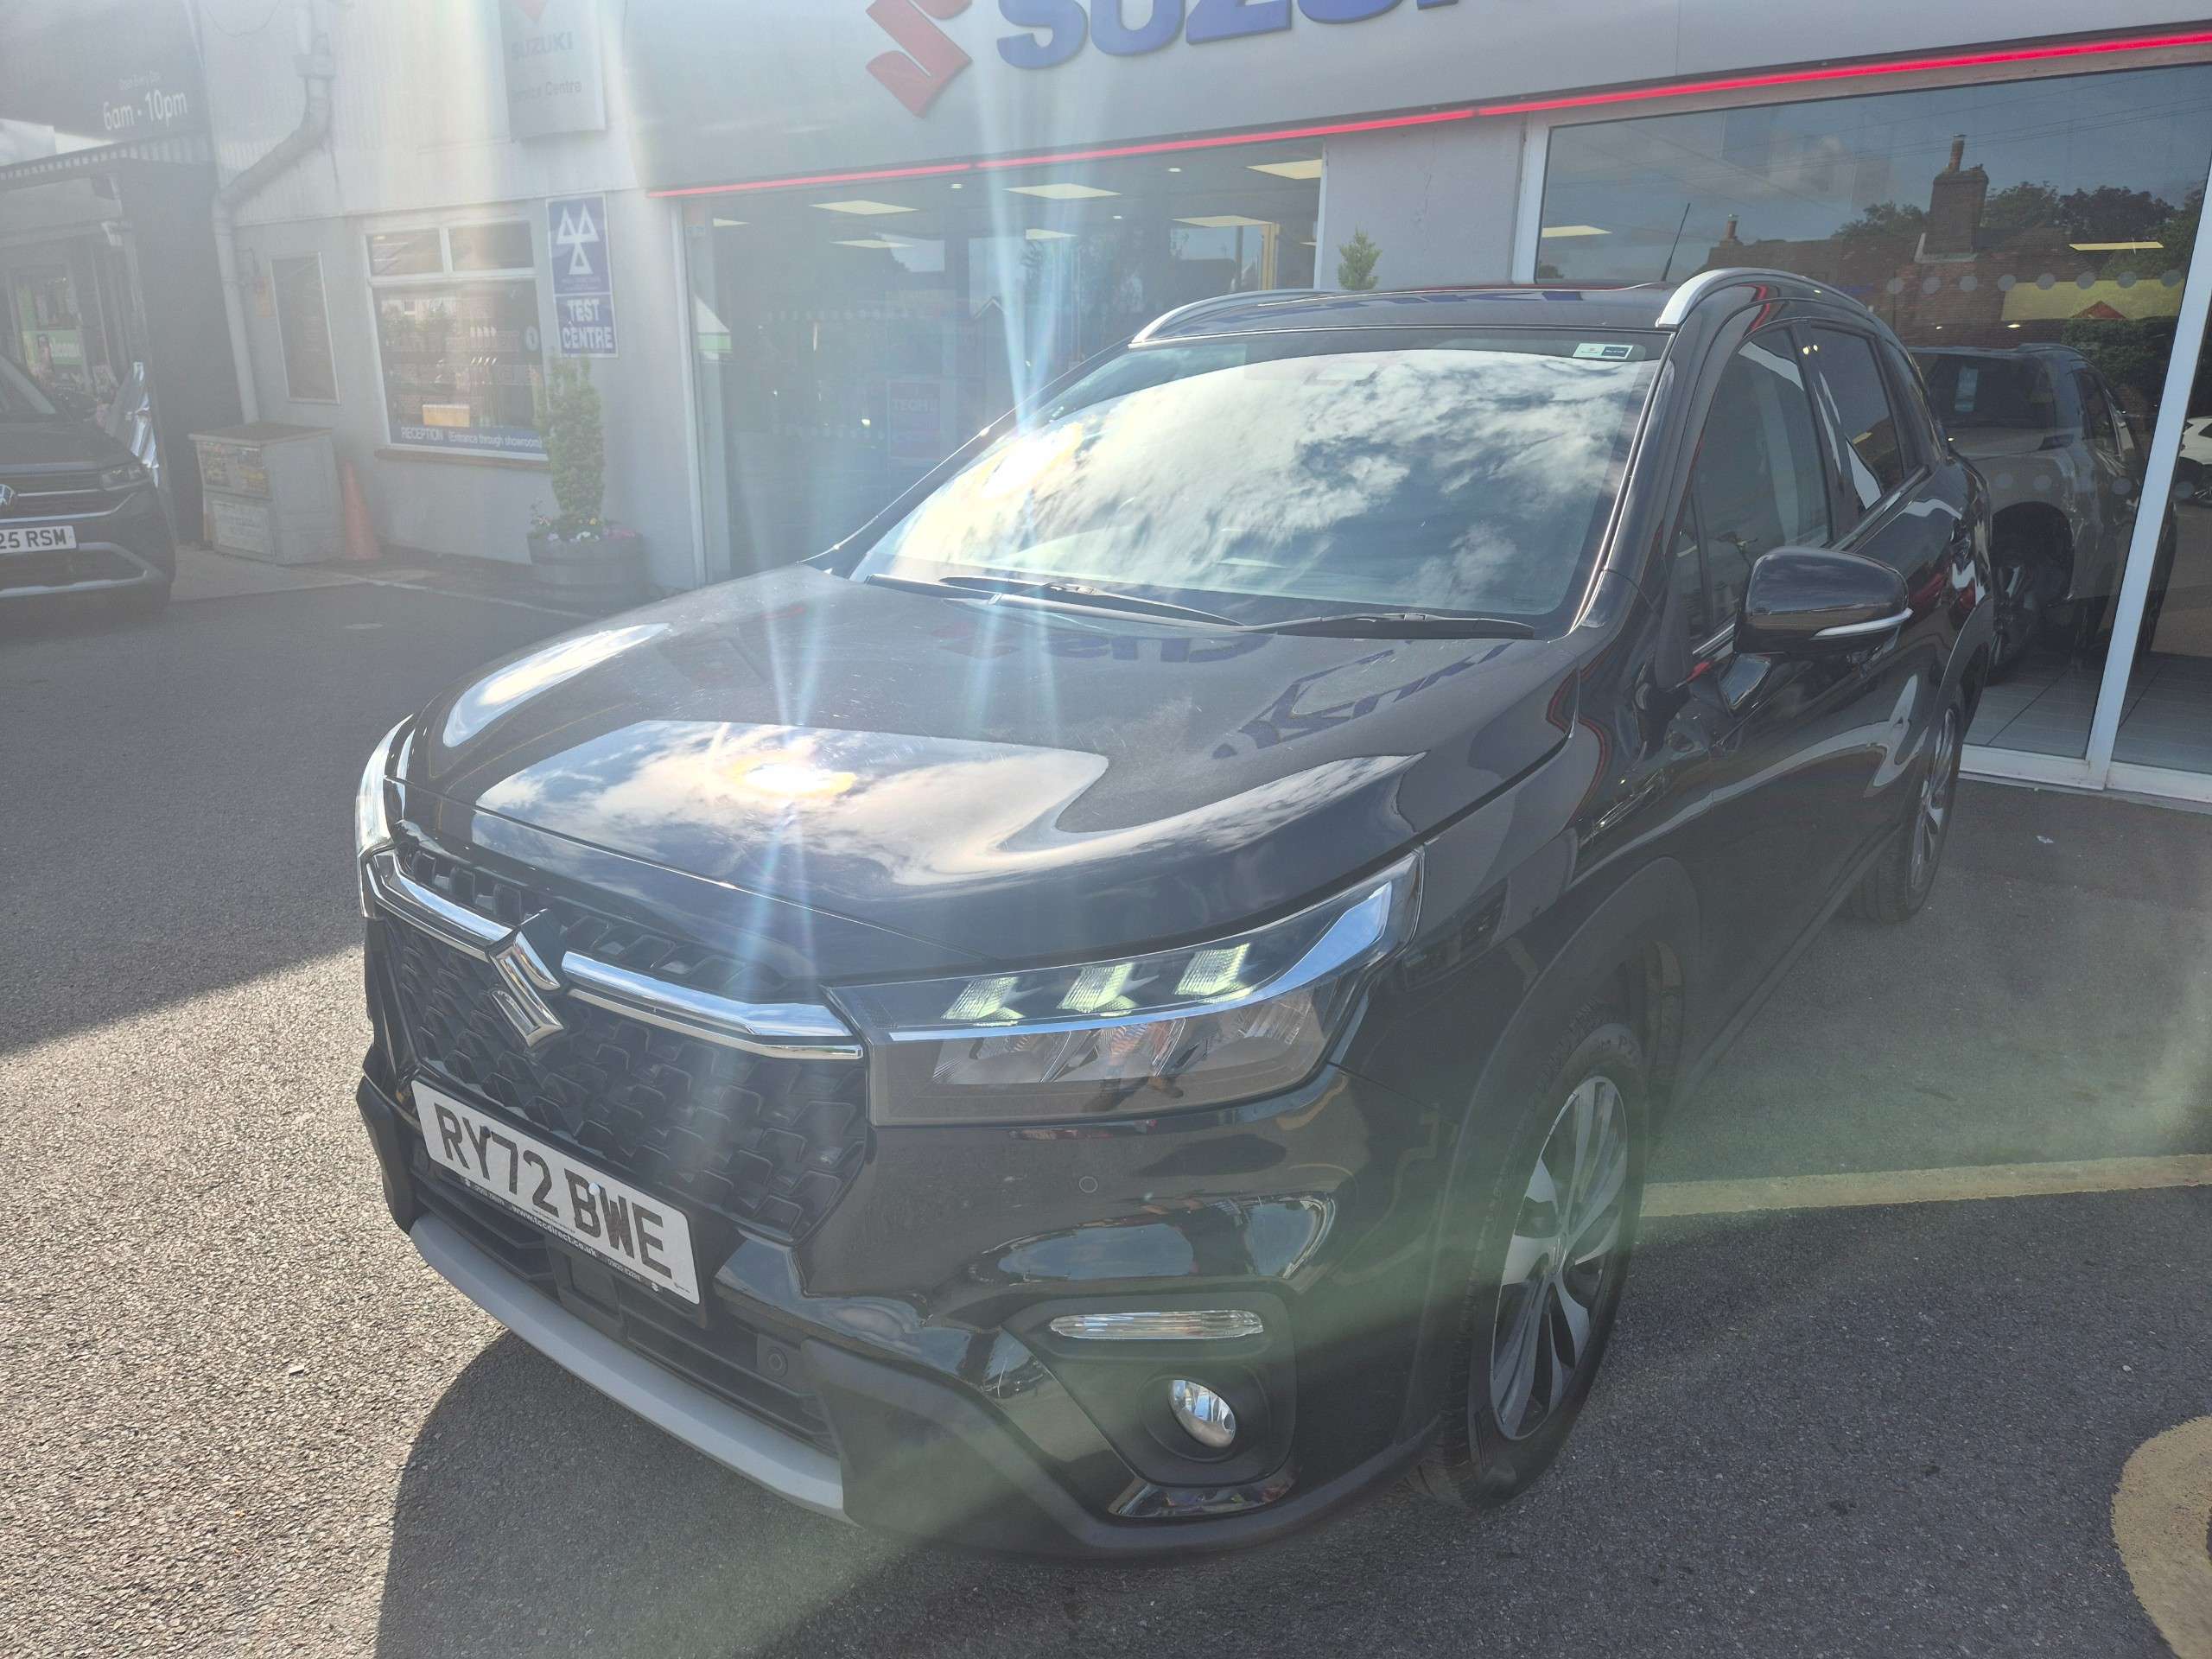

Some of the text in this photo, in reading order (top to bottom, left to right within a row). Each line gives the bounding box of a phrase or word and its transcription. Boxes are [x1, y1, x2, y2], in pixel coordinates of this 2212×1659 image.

[510, 31, 574, 60] SUZUKI
[545, 79, 582, 97] Centre
[103, 100, 136, 131] 6am
[144, 89, 188, 130] 10pm
[567, 298, 600, 322] TEST
[562, 327, 613, 349] CENTRE
[401, 426, 543, 449] RECEPTION (Entrance through showroom)
[25, 527, 67, 548] RSM
[434, 1102, 673, 1280] RY72 BWE
[512, 1205, 599, 1258] www.tccdirect.co.uk
